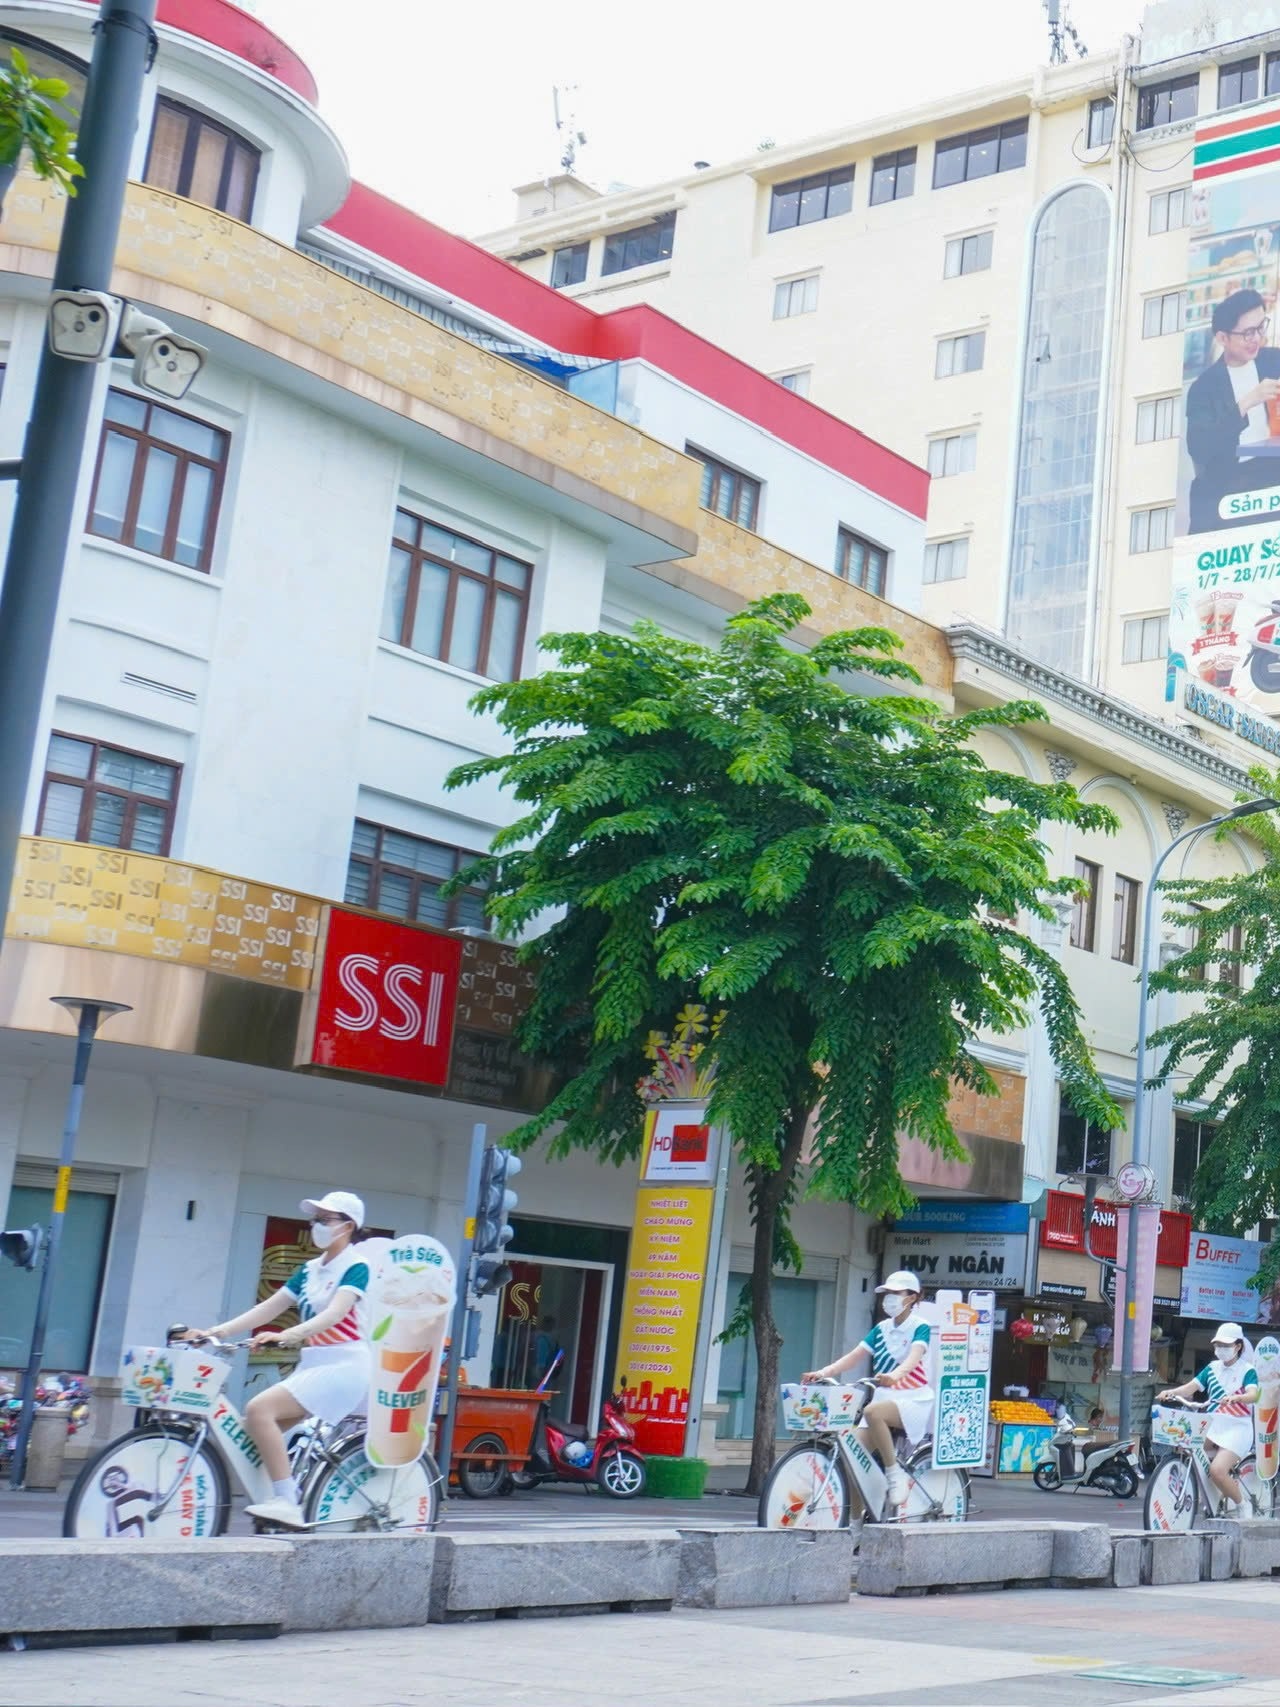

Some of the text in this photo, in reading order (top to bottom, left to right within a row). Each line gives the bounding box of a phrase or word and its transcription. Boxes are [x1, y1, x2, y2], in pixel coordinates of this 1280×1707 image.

[1230, 494, 1263, 514] Sản
[1197, 543, 1254, 571] QUAY
[1198, 572, 1219, 590] 1/7
[1186, 683, 1235, 731] OSCAR
[221, 880, 247, 900] SSI
[271, 892, 296, 912] SSI
[243, 904, 269, 924] SSI
[215, 914, 242, 936] SSI
[295, 916, 319, 936] SSI
[265, 927, 291, 947] SSI
[239, 938, 264, 958] SSI
[334, 953, 444, 1047] SSI
[1083, 1205, 1116, 1227] ÁNH
[912, 1237, 931, 1246] Mart
[390, 1245, 443, 1266] Trà Sữa
[900, 1250, 1005, 1274] HUY NGÂN
[994, 1277, 1017, 1287] 24/24
[382, 1348, 432, 1433] 7
[1259, 1406, 1278, 1458] 7
